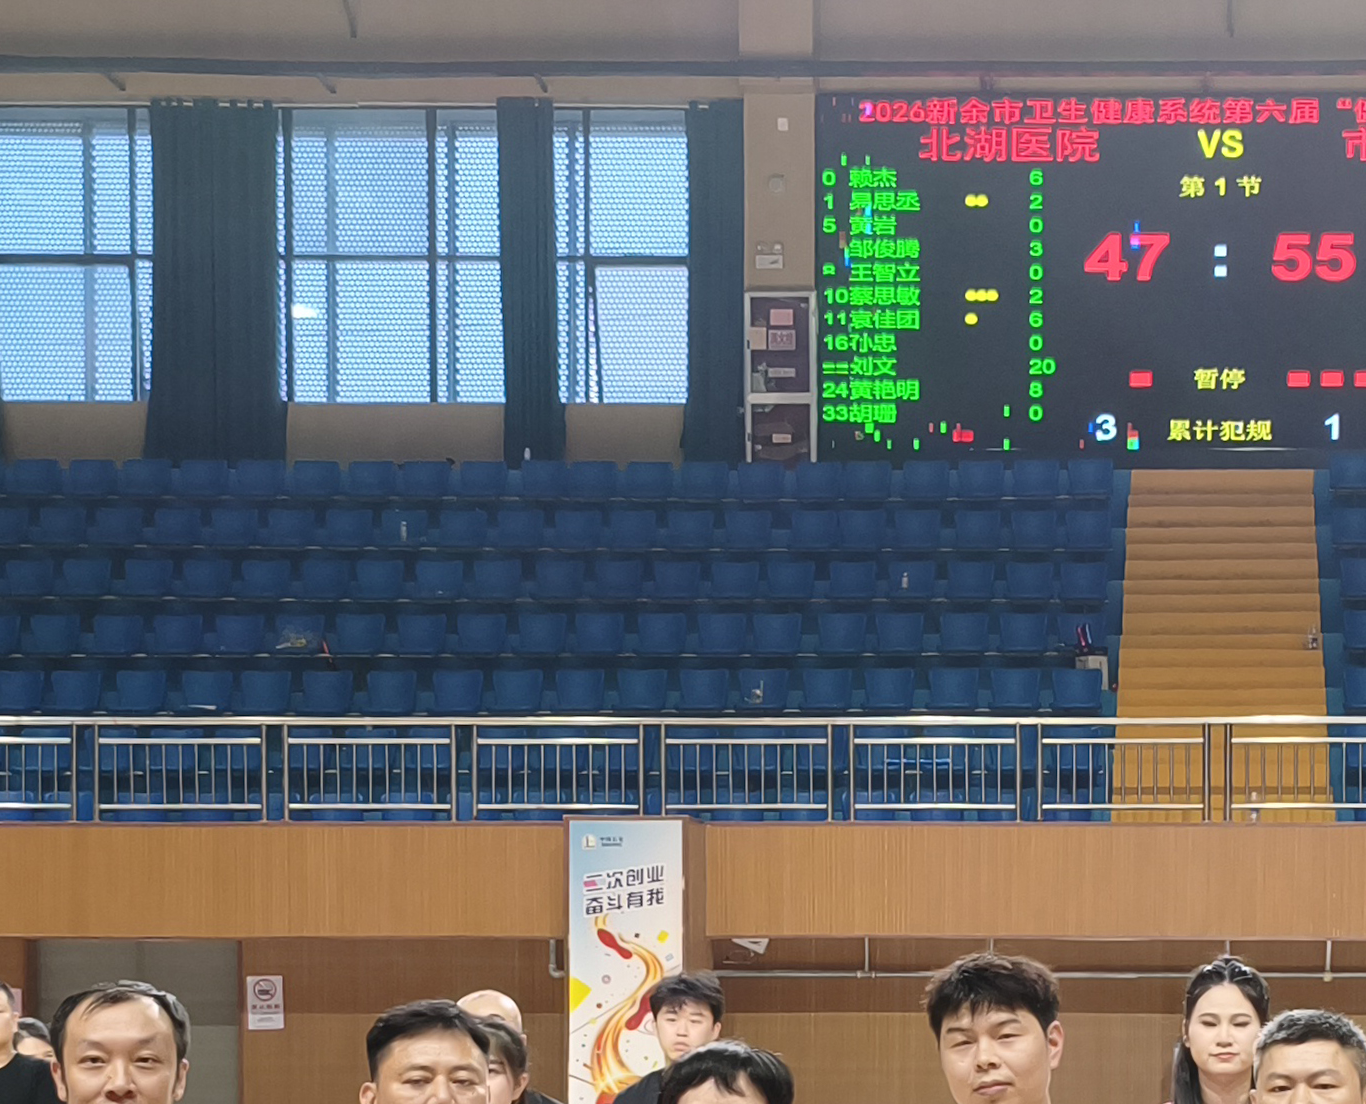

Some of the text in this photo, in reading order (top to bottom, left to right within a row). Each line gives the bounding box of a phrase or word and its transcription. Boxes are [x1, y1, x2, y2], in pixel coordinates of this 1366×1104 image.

[918, 127, 1100, 162] 北湖医院
[1198, 129, 1244, 158] VS
[822, 168, 1044, 188] 0 赖杰 6
[823, 193, 834, 210] 1
[1029, 193, 1044, 210] 2
[822, 216, 837, 233] 5
[1029, 216, 1044, 233] 0
[848, 238, 1044, 259] 邹俊腾 3
[1084, 232, 1170, 282] 47
[1271, 232, 1358, 282] 55
[848, 262, 921, 282] 王智立
[1029, 263, 1044, 281] 0
[823, 285, 1044, 306] 10 蔡思敏 2
[823, 309, 847, 327] 11
[1029, 311, 1044, 328] 6
[823, 332, 1044, 353] 16 孙忠 0
[849, 356, 897, 376] 刘文
[1029, 358, 1057, 375] 20
[1193, 367, 1246, 390] 暂停
[822, 379, 1044, 400] 24 黄艳明 8
[822, 403, 1044, 423] 33 胡珊 0
[1095, 413, 1117, 442] 3
[1167, 419, 1273, 442] 累计犯规
[1324, 413, 1340, 441] 1
